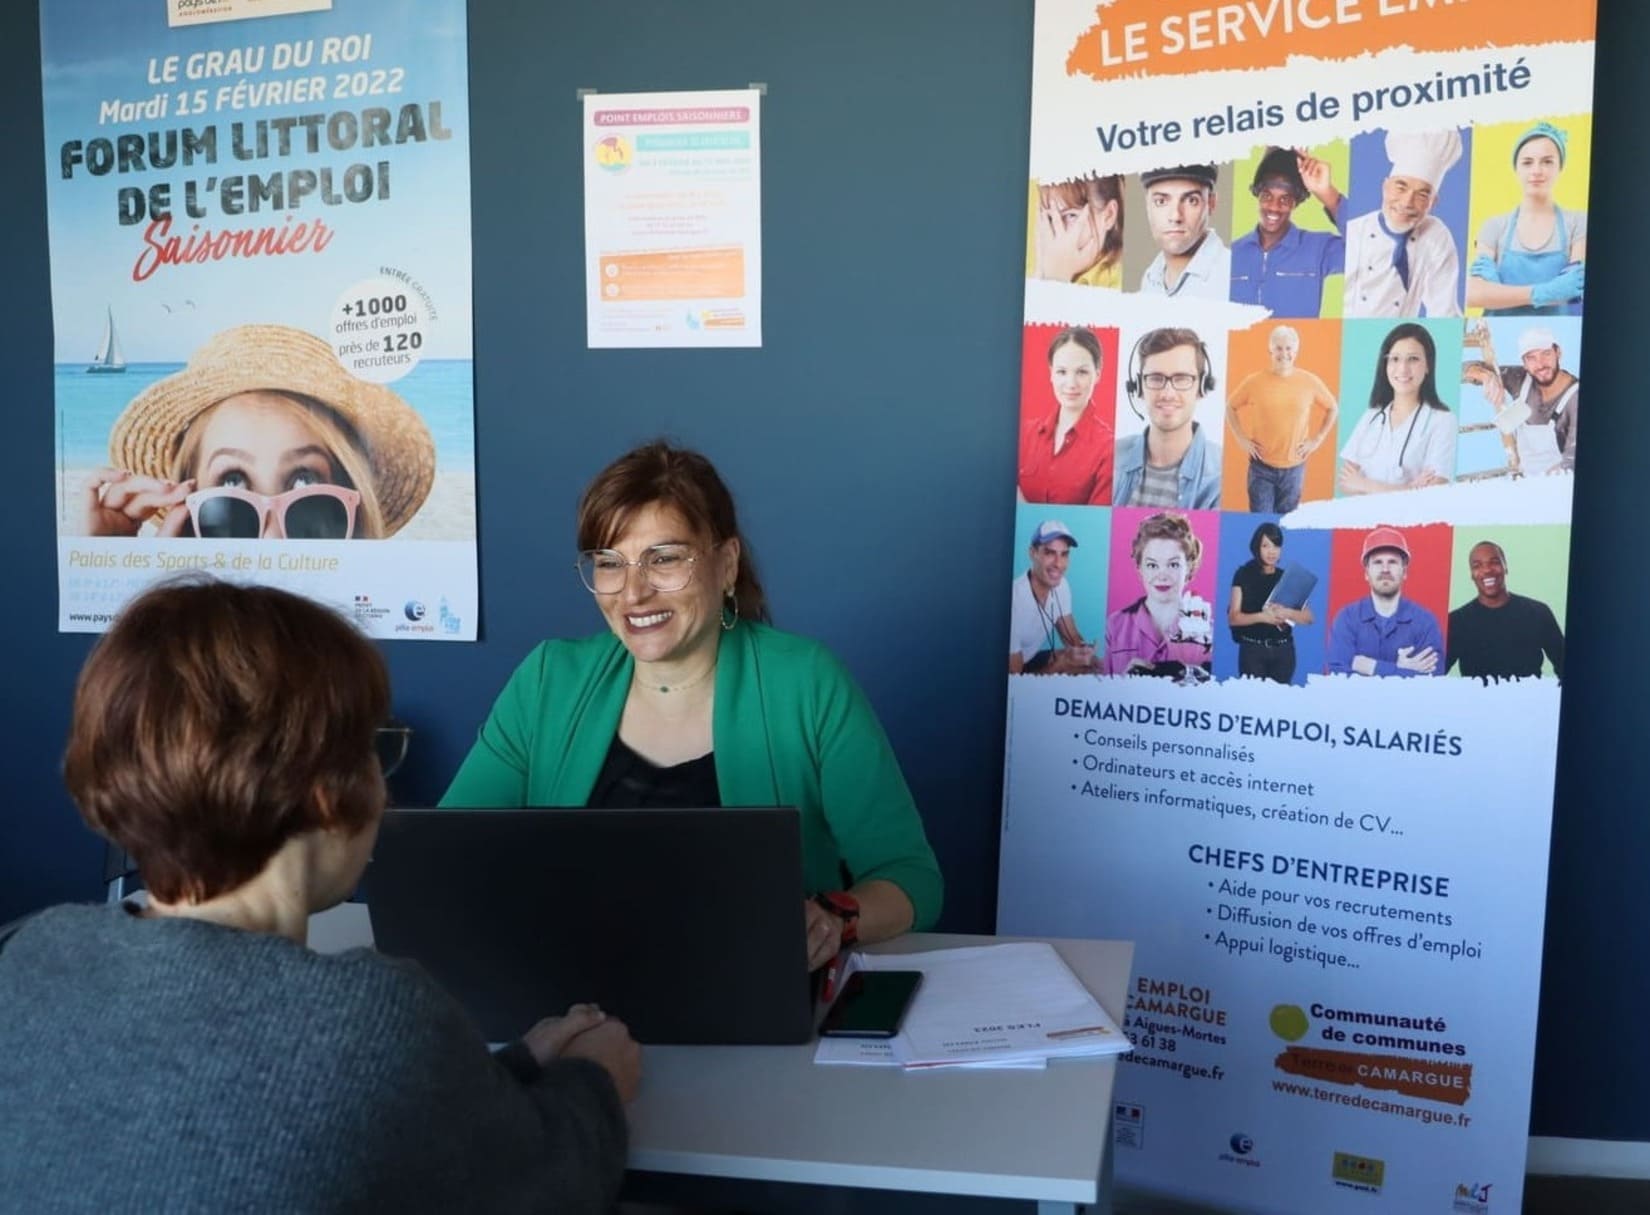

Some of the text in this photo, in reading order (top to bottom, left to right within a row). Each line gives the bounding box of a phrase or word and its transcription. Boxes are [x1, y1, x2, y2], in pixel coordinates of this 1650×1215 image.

[1100, 0, 1362, 67] LE SERVICE
[147, 34, 373, 85] LE GRAU DU ROI
[99, 68, 405, 126] Mardi 15 FÉVRIER 2022
[1097, 57, 1532, 153] Votre relais de proximité
[60, 101, 452, 180] FORUM LITTORAL
[117, 160, 391, 226] DE L'EMPLOI
[131, 212, 335, 282] Saisonnier
[336, 312, 417, 334] offres d'emploi
[342, 294, 407, 317] +1000
[339, 331, 423, 357] près de 120
[353, 352, 411, 369] recruteurs
[69, 550, 339, 573] Palais des Sports & de la Culture
[1055, 698, 1463, 757] DEMANDEURS D'EMPLOI, SALARIÉS
[1084, 729, 1255, 764] Conseils personnalisés
[1083, 754, 1315, 797] Ordinateurs et accès internet
[1080, 780, 1140, 803] Ateliers
[1144, 787, 1257, 820] informatiques,
[1261, 803, 1330, 826] création
[1334, 811, 1355, 830] de
[1188, 843, 1450, 898] CHEFS D'ENTREPRISE
[1218, 877, 1453, 927] Aide pour vos recrutements
[1214, 930, 1264, 956] Appui
[1217, 903, 1482, 961] Diffusion de vos offres d'emploi
[1137, 976, 1211, 1006] EMPLOI
[1133, 1015, 1227, 1045] Aigues-Mortes
[1310, 1003, 1447, 1033] Communauté
[1141, 1034, 1156, 1048] 61
[1159, 1038, 1177, 1053] 38
[1322, 1026, 1466, 1057] de communes
[1118, 1050, 1225, 1080] edecamargue.fr
[1357, 1064, 1464, 1089] CAMARGUE
[1272, 1080, 1472, 1128] www.terredecamargue.fr
